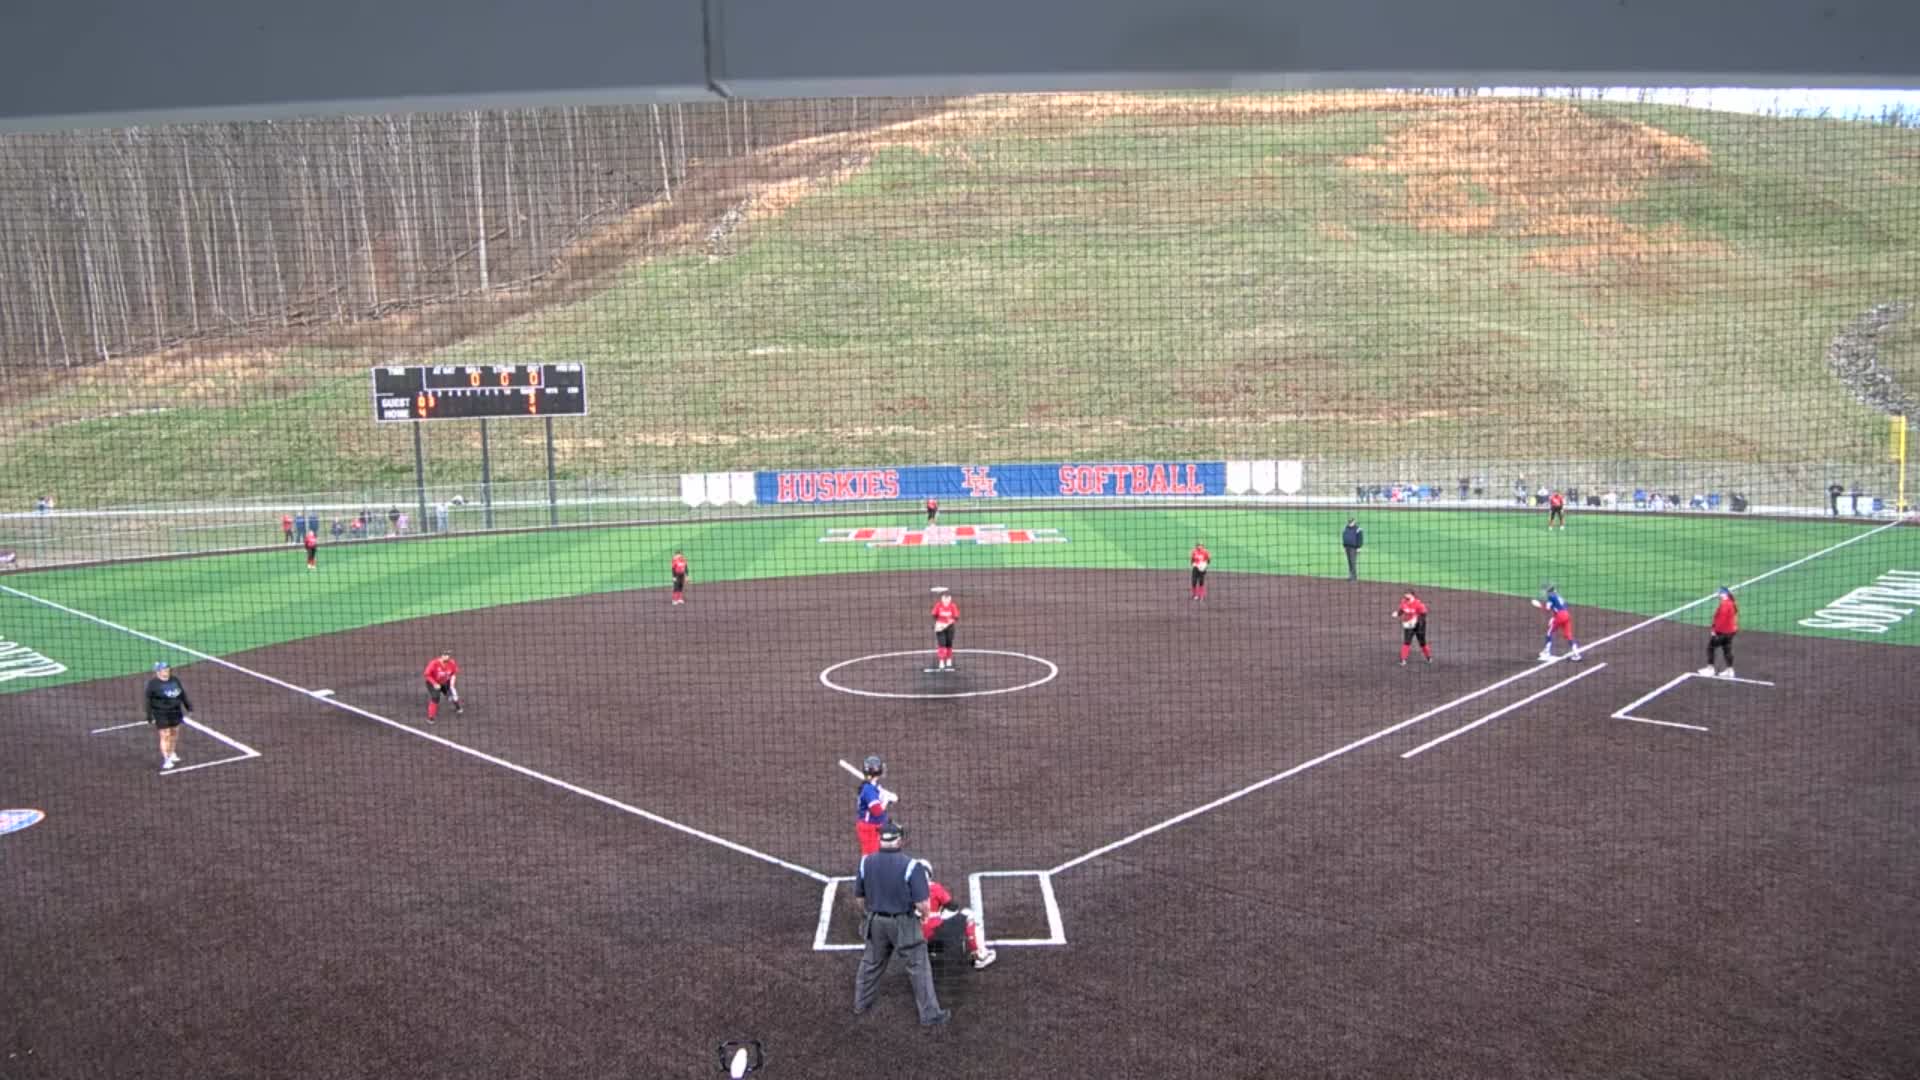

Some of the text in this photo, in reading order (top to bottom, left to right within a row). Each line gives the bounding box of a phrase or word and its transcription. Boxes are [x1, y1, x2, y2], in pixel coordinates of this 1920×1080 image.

[470, 372, 481, 387] 0
[500, 372, 510, 387] 0
[529, 370, 539, 386] 0
[776, 469, 900, 503] HUSKIES
[1058, 463, 1205, 496] SOFTBALL
